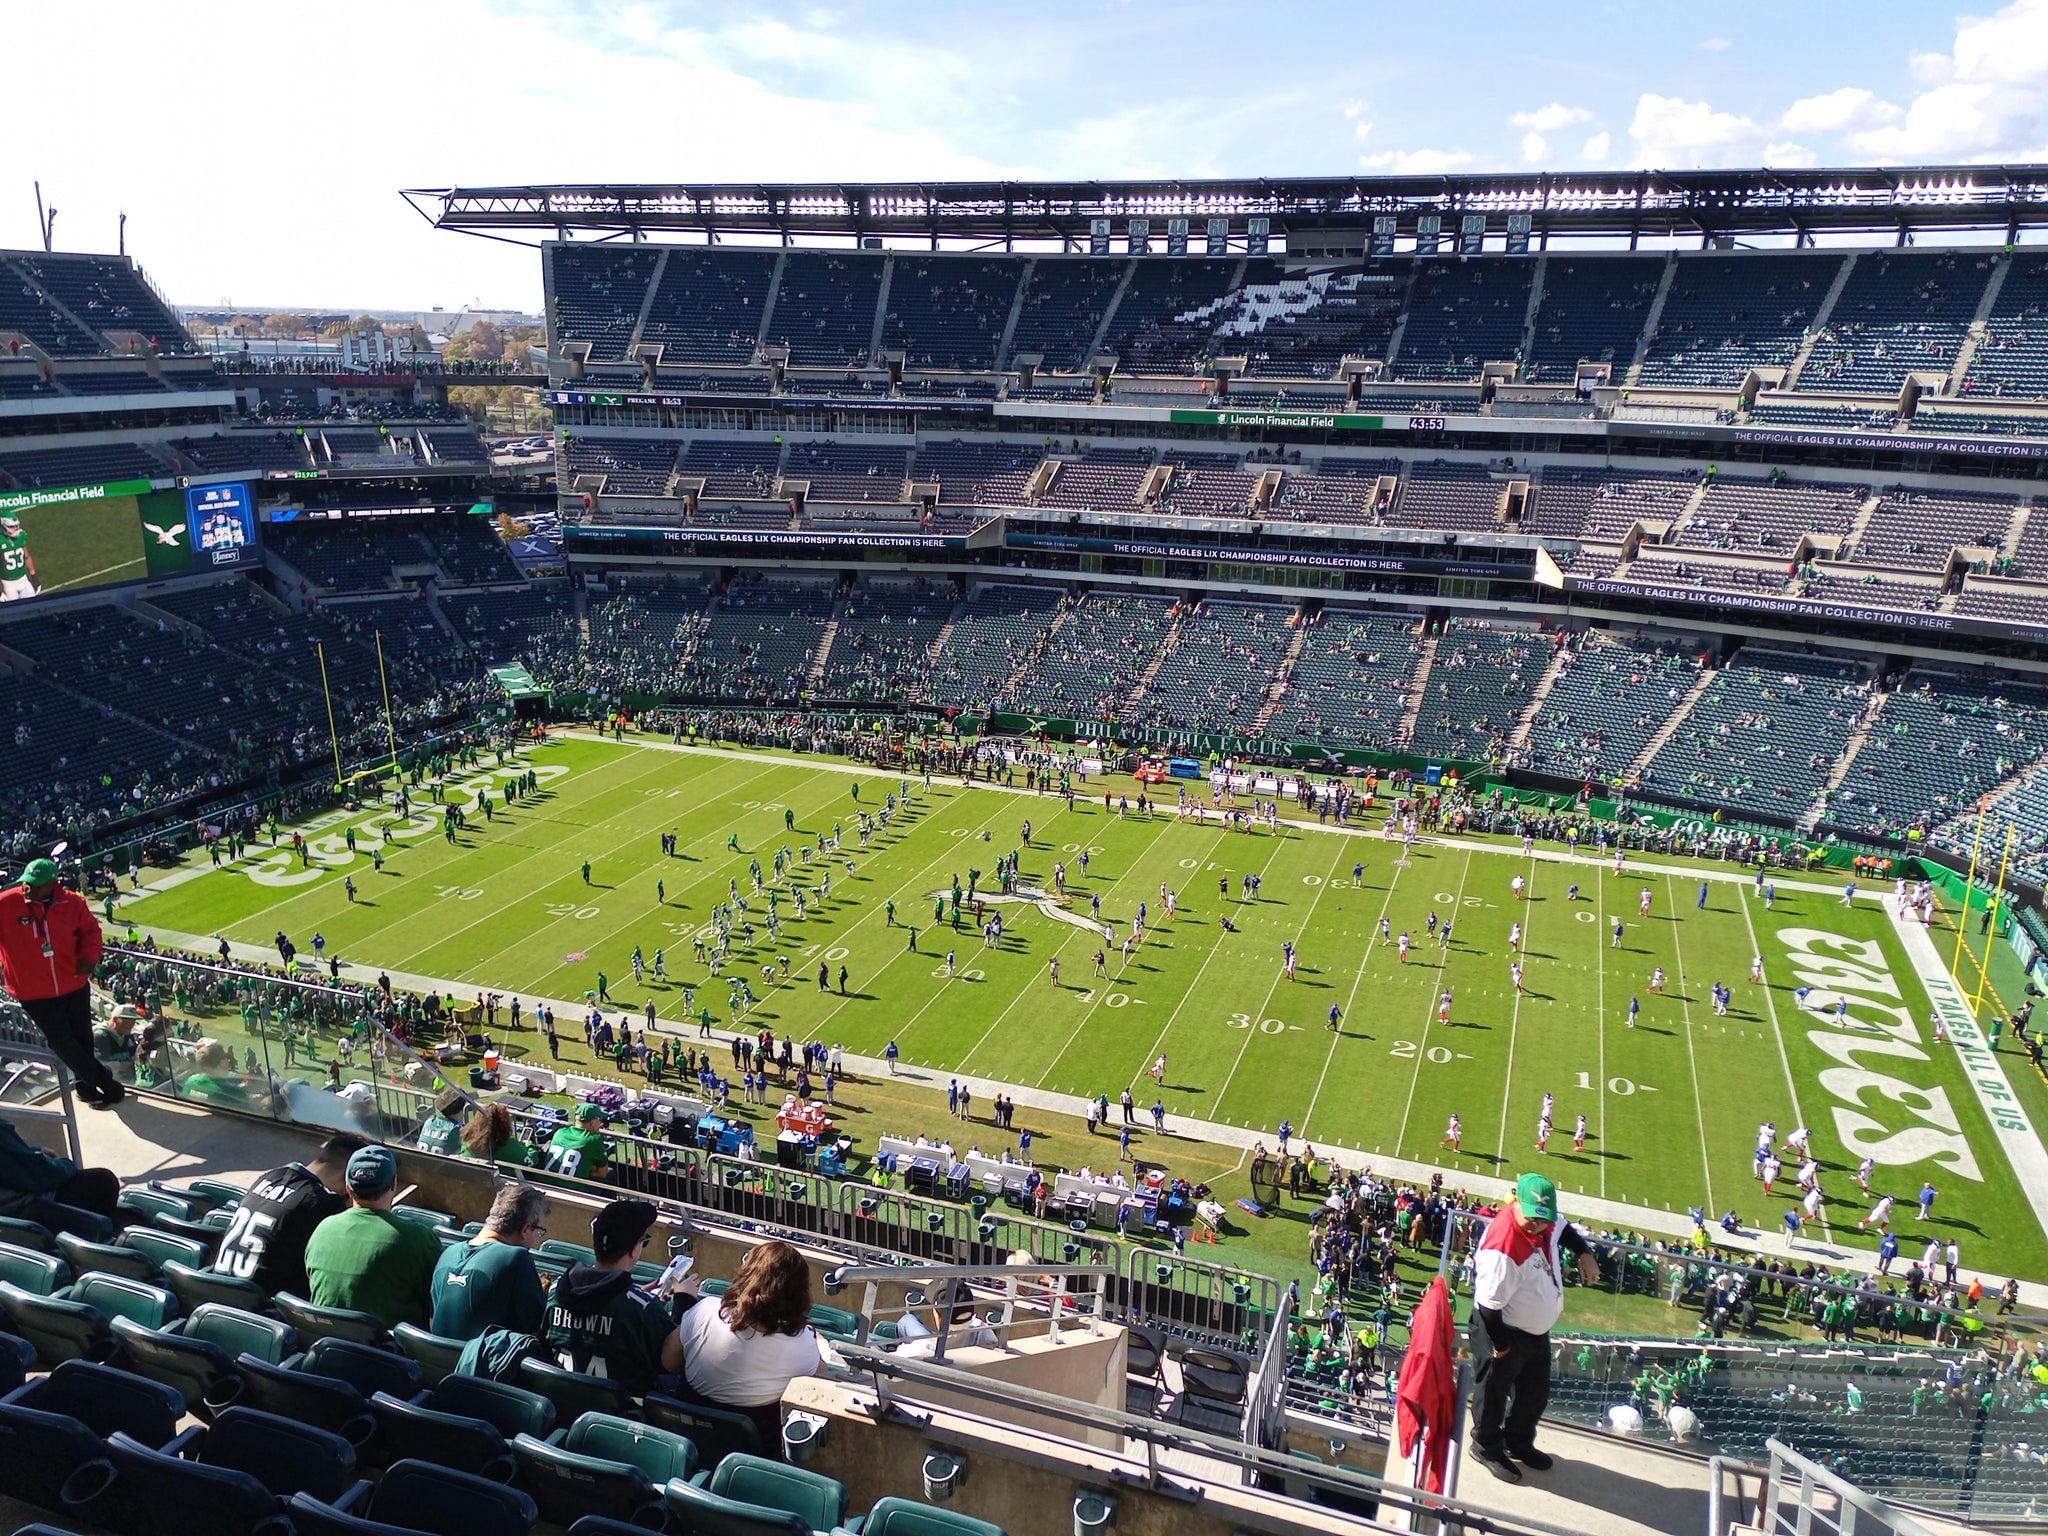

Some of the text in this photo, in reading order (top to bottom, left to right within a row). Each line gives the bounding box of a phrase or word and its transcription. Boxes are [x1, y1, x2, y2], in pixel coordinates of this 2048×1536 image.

[342, 330, 411, 373] Lite
[662, 398, 682, 406] 43:53
[1230, 414, 1334, 428] Lincoln Financial Field
[1410, 418, 1444, 430] 43:53
[1734, 432, 2042, 456] THE OFFICIAL EAGLES LIX CHAMPIONSHIP FAN COLLECTION IS
[0, 486, 104, 507] ncoln Financial Field
[664, 532, 680, 540] THE
[681, 533, 718, 541] OFFICIAL
[720, 534, 753, 542] EAGLES
[755, 534, 768, 542] LIX
[770, 535, 836, 544] CHAMPIONSHIP
[838, 537, 855, 545] FAN
[857, 537, 911, 546] COLLECTION
[922, 539, 946, 547] HERE.
[4, 548, 25, 571] 53
[1114, 544, 1405, 570] THE OFFICIAL EAGLES LIX CHAMPIONSHIP FAN COLLECTION IS HERE.
[1576, 580, 1954, 629] THE OFFICIAL EAGLES LIX CHAMPIONSHIP FAN COLLECTION IS HERE.
[1220, 737, 1292, 757] EAGLES
[1672, 818, 1704, 834] GO
[1303, 875, 1350, 890] 30
[1433, 892, 1484, 908] 20
[546, 903, 600, 920] 20
[798, 943, 850, 961] 40
[1074, 989, 1129, 1008] 40
[1226, 1013, 1285, 1034] 30
[1389, 1040, 1452, 1064] 20
[1776, 928, 1984, 1182] EAGLES
[1926, 978, 2028, 1132] IT TAKES ALL OF US
[1574, 1071, 1636, 1096] 10
[806, 1124, 814, 1134] G
[544, 1145, 582, 1178] 78
[213, 1206, 278, 1278] 25
[552, 1306, 614, 1336] BROWN
